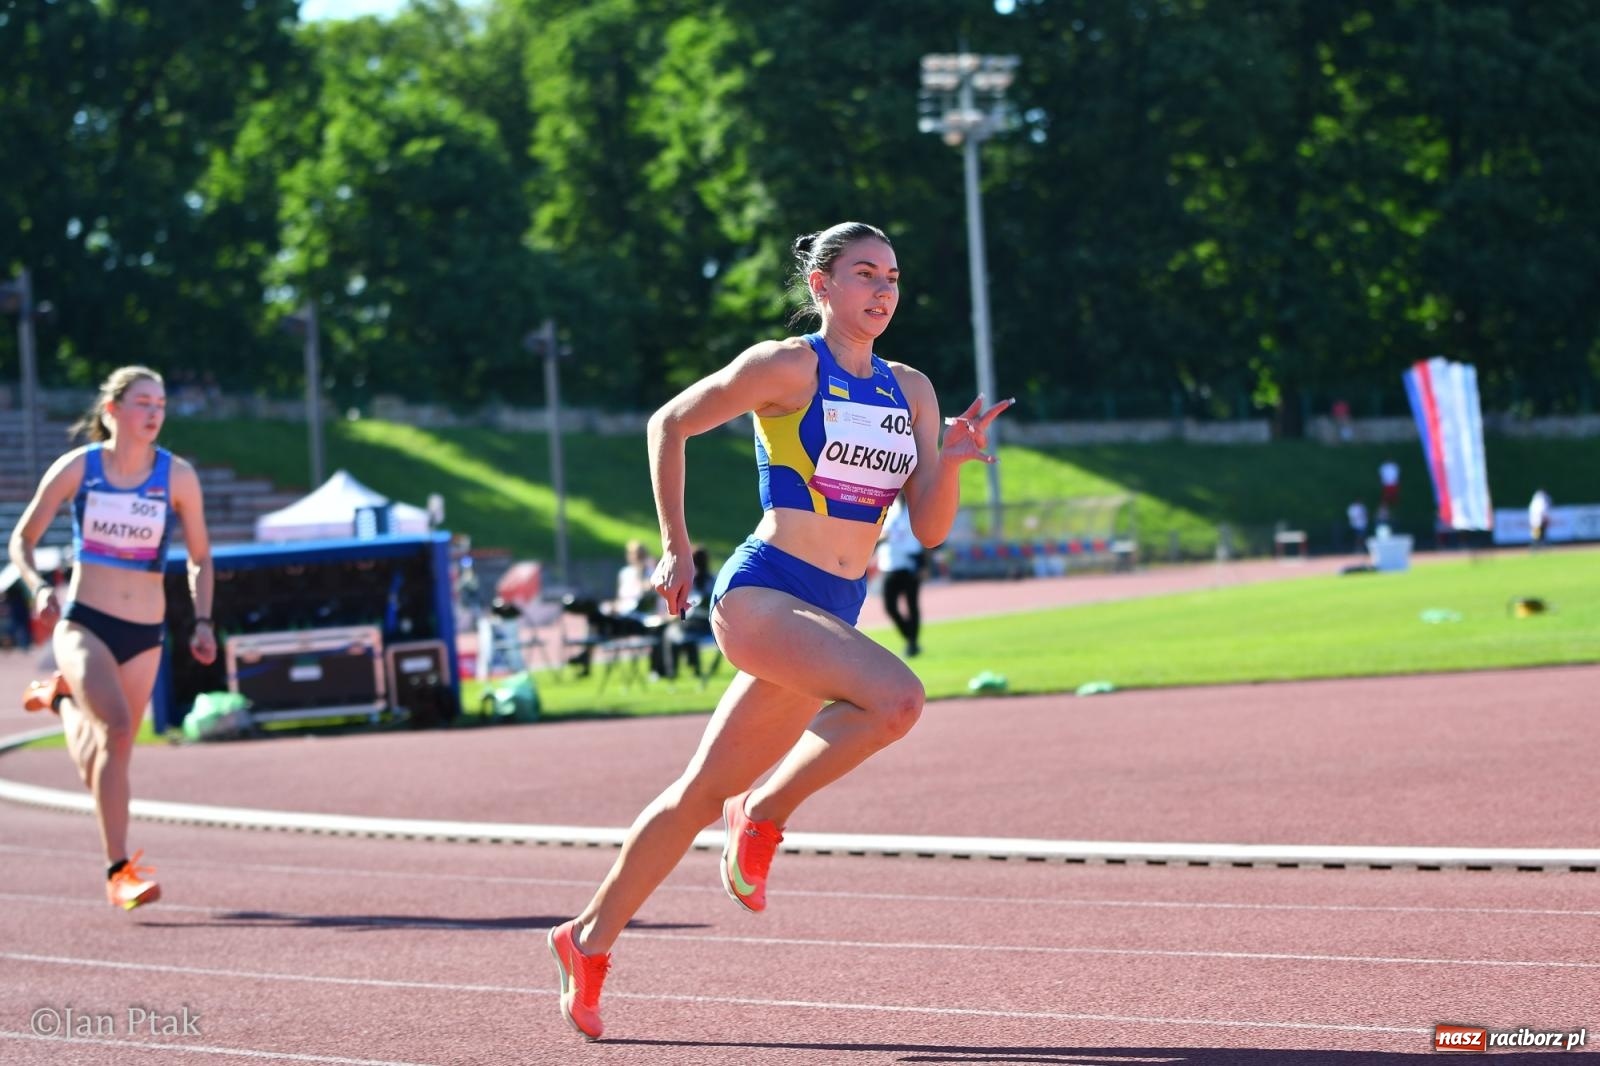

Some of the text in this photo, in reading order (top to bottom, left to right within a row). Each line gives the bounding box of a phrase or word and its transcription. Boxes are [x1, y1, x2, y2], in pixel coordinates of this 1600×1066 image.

[825, 441, 914, 474] OLEKSIUK
[131, 501, 158, 517] 505
[92, 521, 153, 540] MATKO
